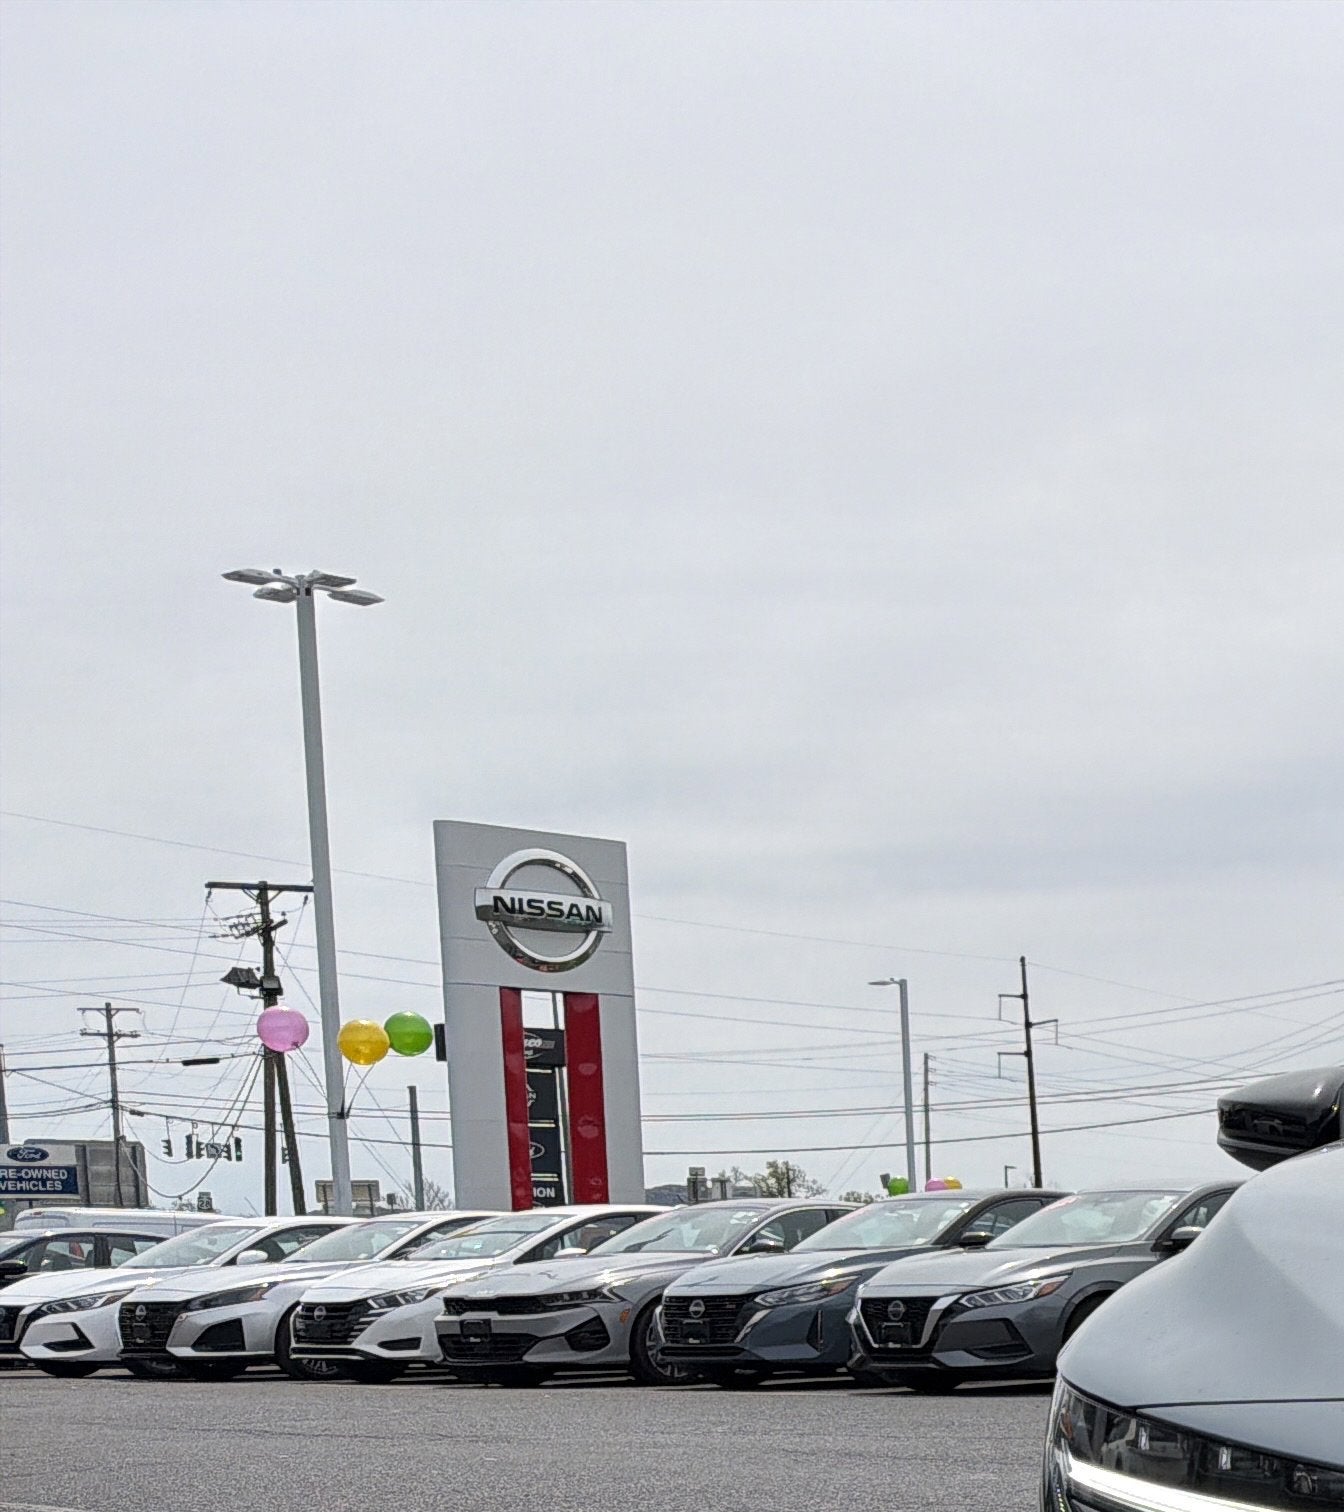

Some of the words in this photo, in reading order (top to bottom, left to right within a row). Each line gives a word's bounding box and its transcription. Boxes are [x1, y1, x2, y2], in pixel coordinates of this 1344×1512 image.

[493, 895, 602, 923] NISSAN
[17, 1148, 41, 1159] Ford
[0, 1181, 62, 1191] VEHICLES
